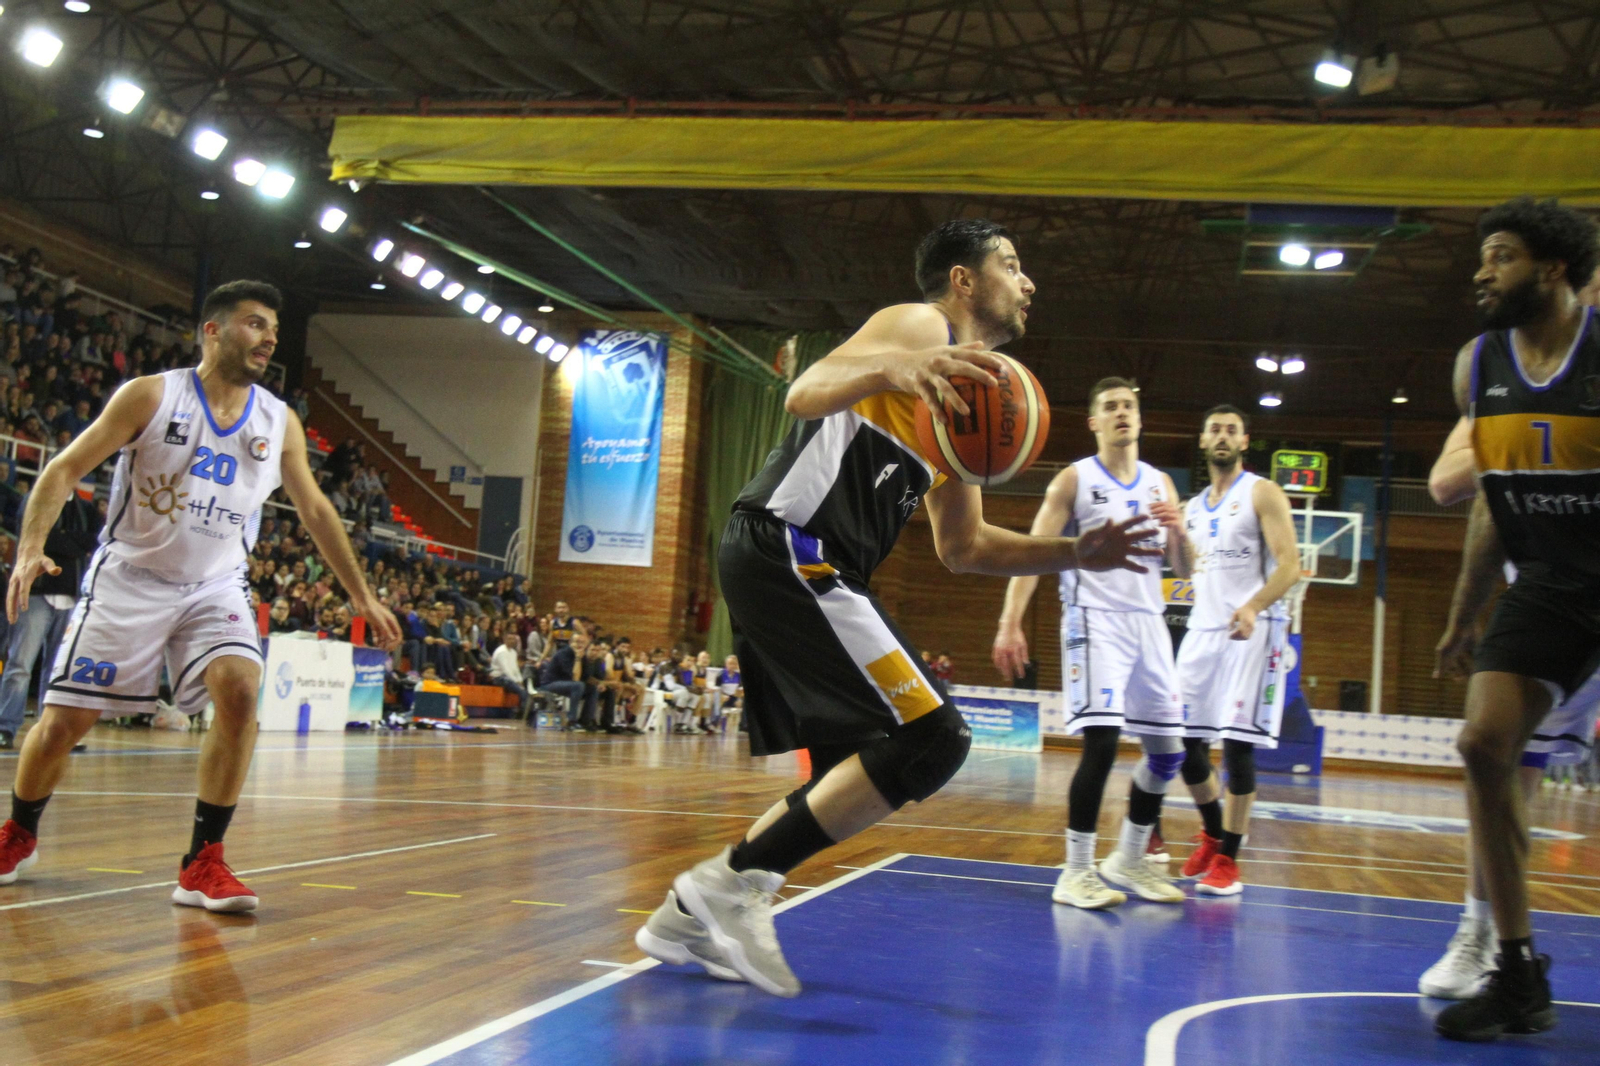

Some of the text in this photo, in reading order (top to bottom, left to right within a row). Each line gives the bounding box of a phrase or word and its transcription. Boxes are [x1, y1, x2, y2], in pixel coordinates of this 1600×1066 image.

[997, 370, 1019, 447] molten
[189, 445, 238, 487] 20
[581, 449, 651, 470] tu esfuerzo
[1290, 469, 1315, 486] 17
[1126, 500, 1139, 516] 7
[71, 656, 117, 687] 20
[1101, 689, 1114, 708] 7
